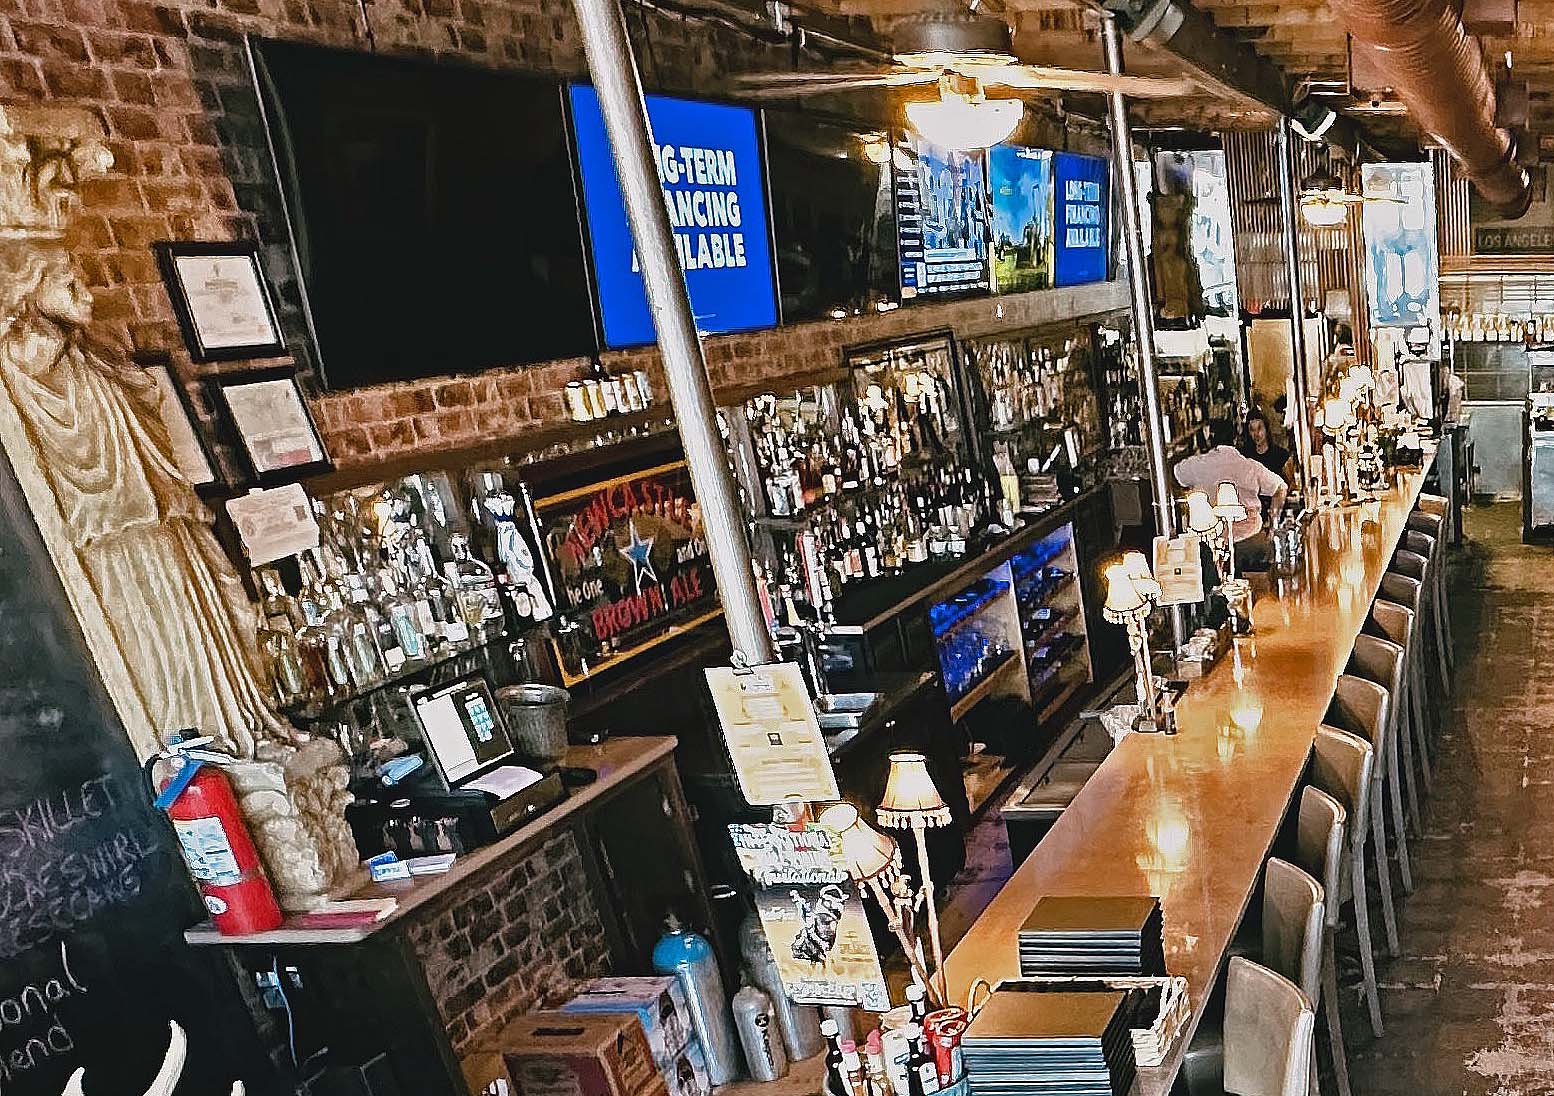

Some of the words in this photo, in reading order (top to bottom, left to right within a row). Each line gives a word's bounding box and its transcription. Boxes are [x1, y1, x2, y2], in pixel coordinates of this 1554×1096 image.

[654, 145, 737, 186] NG-TERM
[664, 190, 741, 228] ANCING
[0, 941, 88, 1025] onal
